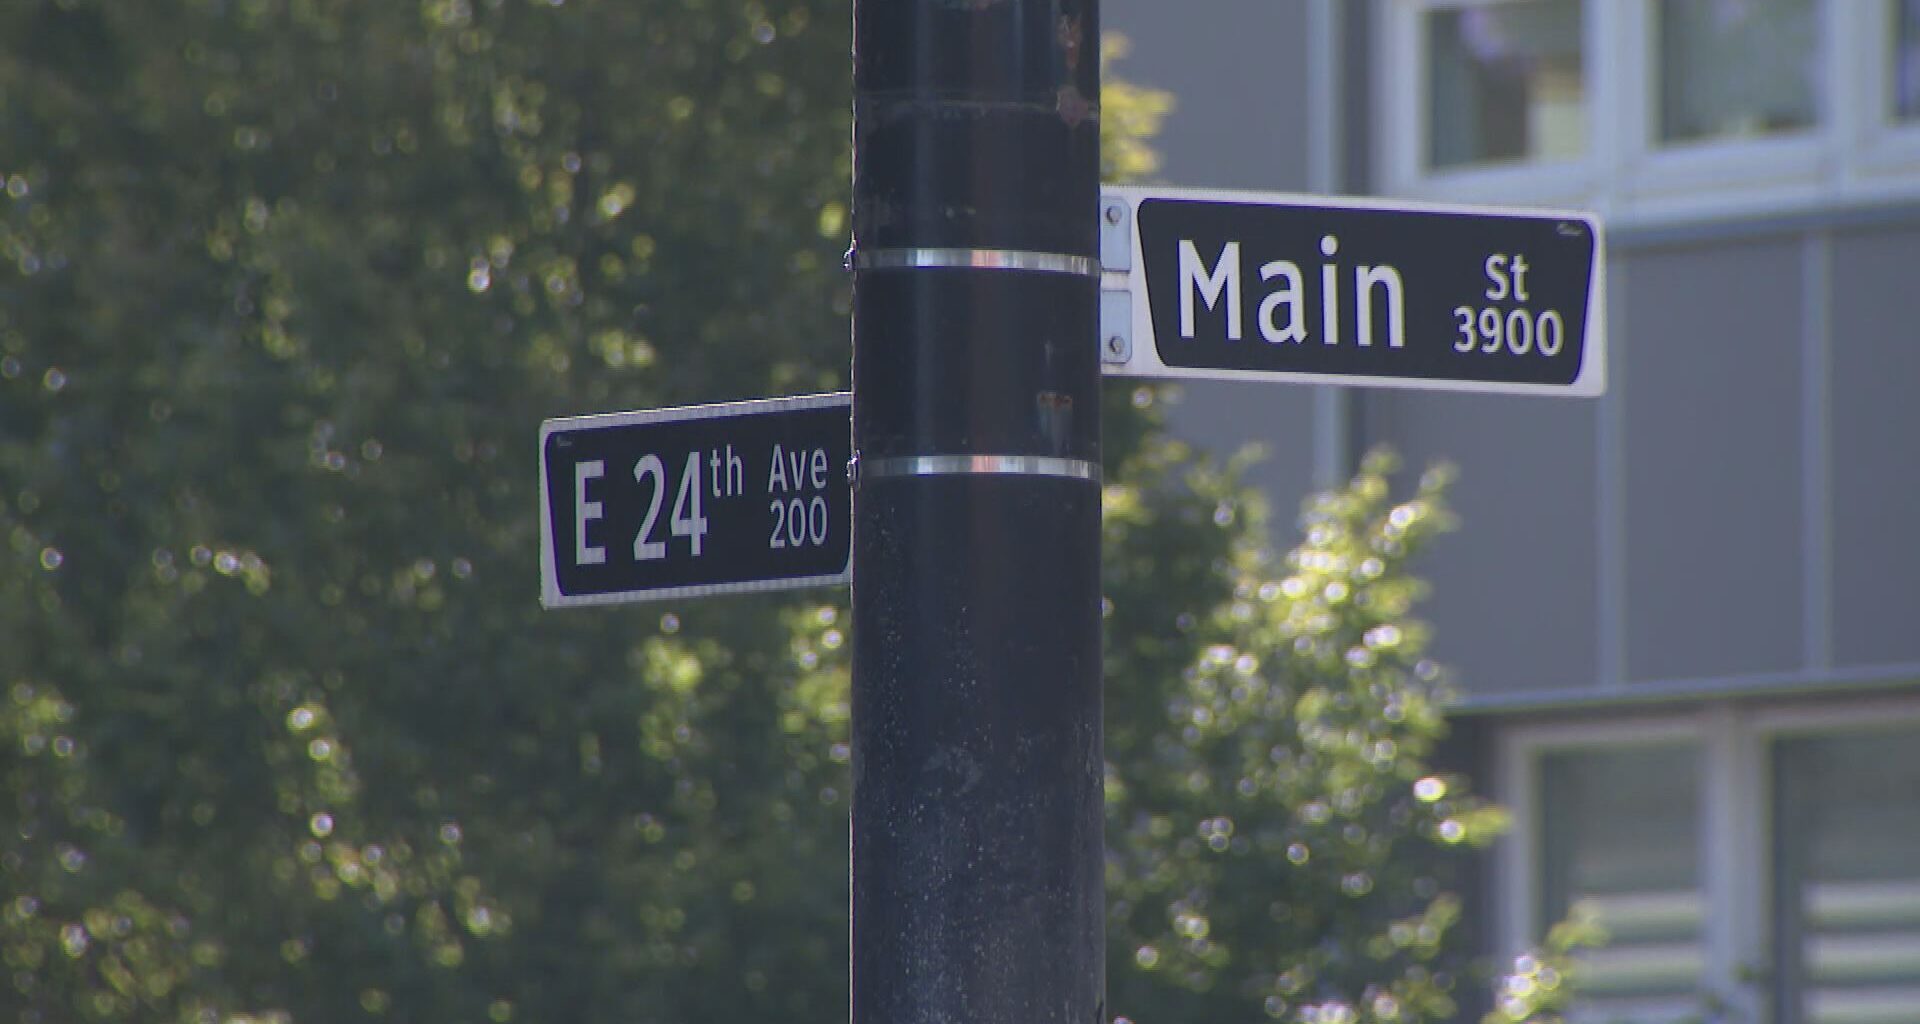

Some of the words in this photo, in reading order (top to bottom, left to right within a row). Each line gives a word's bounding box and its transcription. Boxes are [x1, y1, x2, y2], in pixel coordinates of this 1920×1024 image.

[1178, 235, 1405, 347] Main
[1485, 253, 1530, 302] St
[1453, 305, 1563, 357] 3900
[574, 459, 606, 565] E
[633, 444, 744, 561] 24th
[768, 444, 828, 493] Ave
[769, 496, 828, 549] 200
